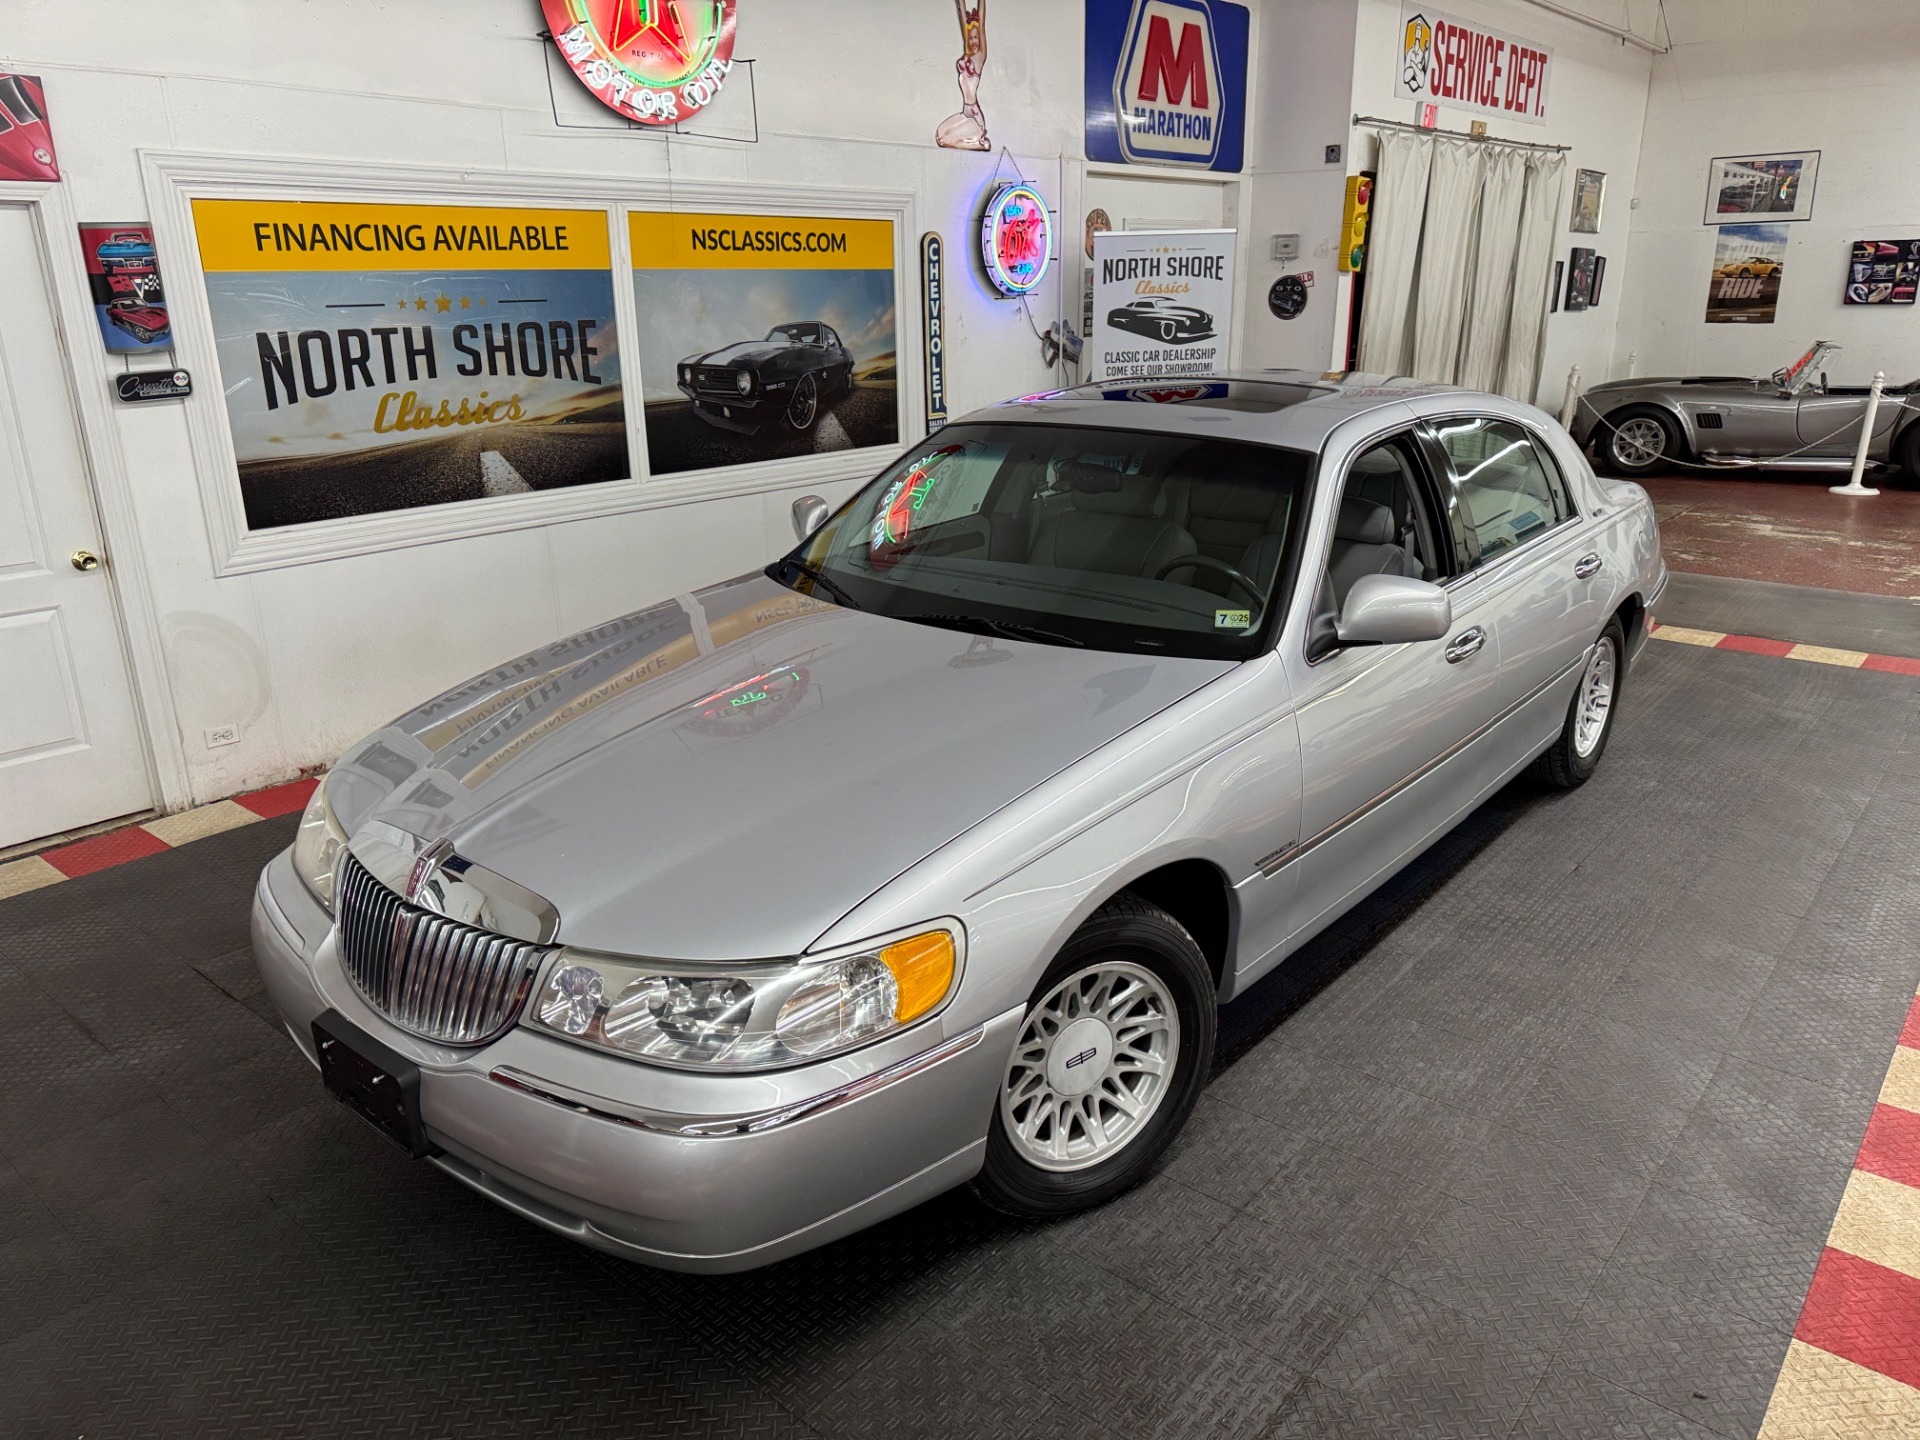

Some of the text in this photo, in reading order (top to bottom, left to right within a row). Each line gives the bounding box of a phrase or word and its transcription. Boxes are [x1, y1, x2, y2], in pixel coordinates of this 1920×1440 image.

[631, 49, 647, 58] REG
[1137, 15, 1209, 110] M
[556, 24, 734, 121] MOTOR OIL
[1430, 20, 1548, 117] SERVICE DEPT.
[1132, 107, 1212, 141] MARATHON
[254, 223, 569, 251] FINANCING AVAILABLE
[691, 229, 847, 252] NSCLASSICS.COM
[1003, 208, 1041, 266] OK
[1103, 256, 1224, 284] NORTH SHORE
[1134, 280, 1191, 295] Classics
[1717, 277, 1764, 299] RIDE
[928, 243, 942, 409] CHEVROLET
[256, 319, 602, 410] NORTH SHORE
[1104, 348, 1217, 364] CLASSIC CAR DEALERSHIP
[1106, 362, 1213, 376] COME SEE OUR SHOWROOM!
[119, 376, 175, 397] Corvette
[373, 390, 528, 434] Classics
[1219, 614, 1249, 624] 7 25
